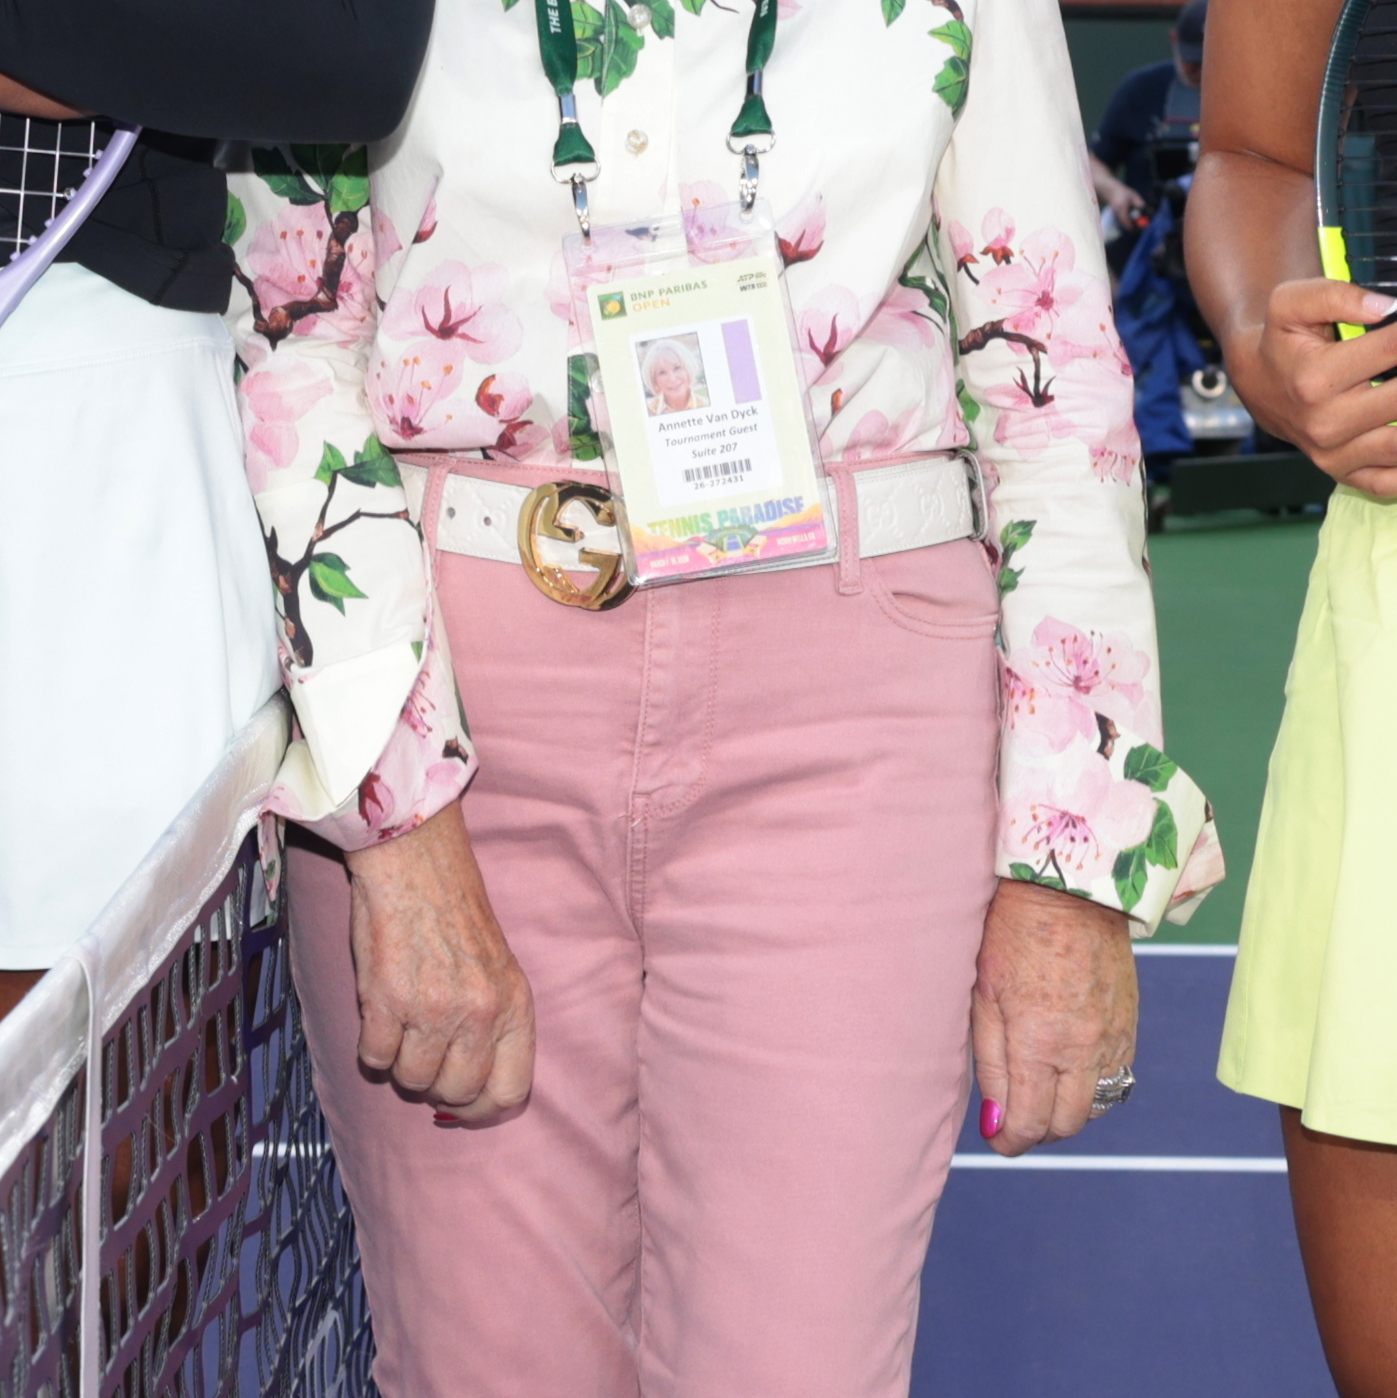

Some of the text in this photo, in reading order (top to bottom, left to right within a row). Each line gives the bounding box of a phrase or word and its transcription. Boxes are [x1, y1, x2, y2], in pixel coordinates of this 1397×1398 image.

[548, 6, 562, 34] THE
[630, 280, 708, 302] BNP PARIBAS
[632, 298, 671, 312] OPEN
[658, 406, 759, 433] Annette Van Dyck
[665, 423, 758, 447] Tournament Guest
[691, 442, 738, 459] Suite 207
[694, 475, 745, 490] 26-272431
[647, 496, 804, 539] TENNIS PARADISE
